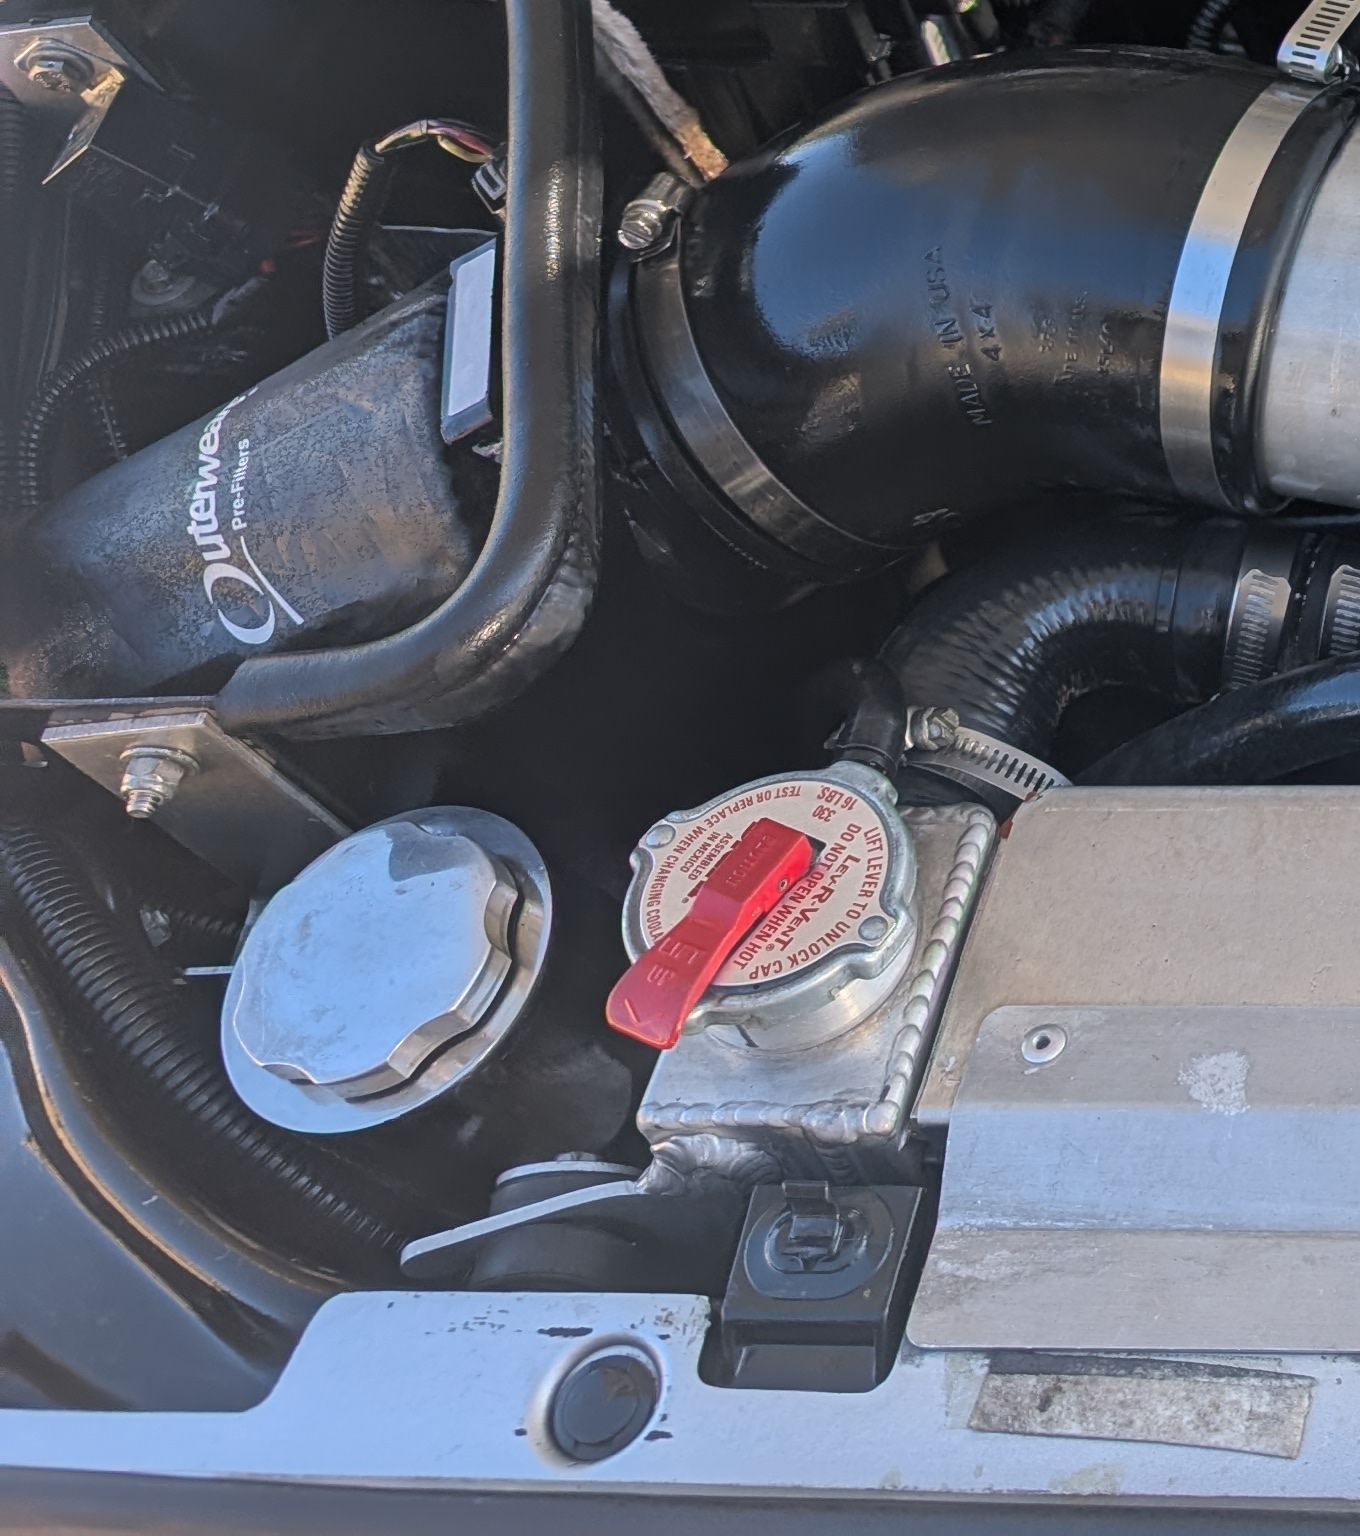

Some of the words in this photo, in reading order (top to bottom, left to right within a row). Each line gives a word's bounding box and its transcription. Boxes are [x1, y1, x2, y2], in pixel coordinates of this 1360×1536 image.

[922, 245, 952, 305] USA
[934, 316, 965, 345] IN
[947, 363, 993, 426] MADE
[231, 438, 251, 531] Pre-Filters
[756, 790, 771, 803] OR
[774, 785, 801, 798] TEST
[816, 784, 844, 807] LBS.
[844, 798, 857, 811] 16
[703, 796, 753, 828] REPLACE
[812, 804, 836, 823] 330
[674, 824, 705, 856] WHEN
[707, 830, 720, 844] IN
[840, 822, 862, 844] DO
[863, 826, 882, 859] LIFT
[679, 837, 709, 873] MEXICO
[687, 832, 733, 880] ASSEMBLED
[818, 841, 842, 874] NOT
[646, 854, 677, 908] CHANGING
[789, 870, 821, 904] OPEN
[858, 858, 881, 898] LEVER
[644, 907, 663, 943] COOLA
[755, 900, 796, 944] WHEN
[845, 899, 868, 920] TO
[732, 937, 760, 971] HOT
[788, 920, 851, 968] UNLOCK
[748, 959, 783, 980] CAP
